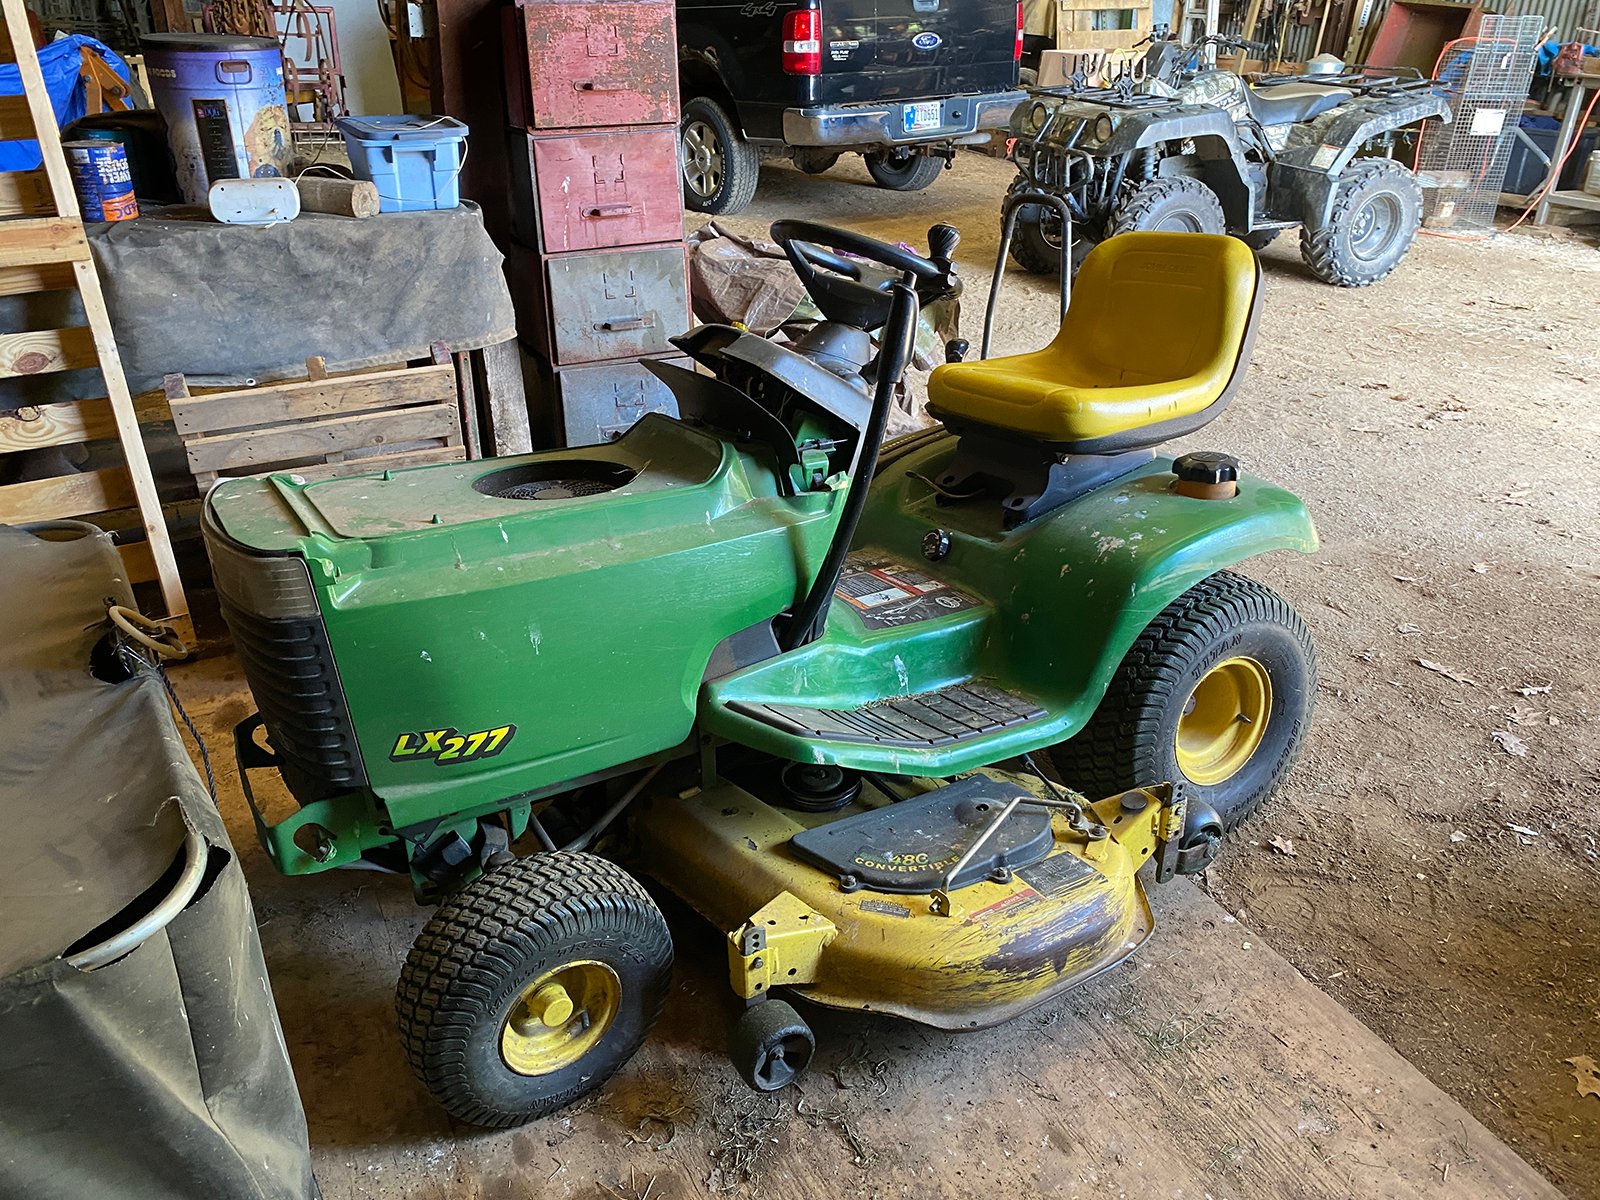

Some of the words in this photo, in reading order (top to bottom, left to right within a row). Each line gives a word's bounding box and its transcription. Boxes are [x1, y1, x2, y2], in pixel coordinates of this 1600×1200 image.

[1191, 633, 1242, 681] TITAN
[854, 854, 961, 873] CONVERTIBLE
[889, 852, 929, 866] 48C
